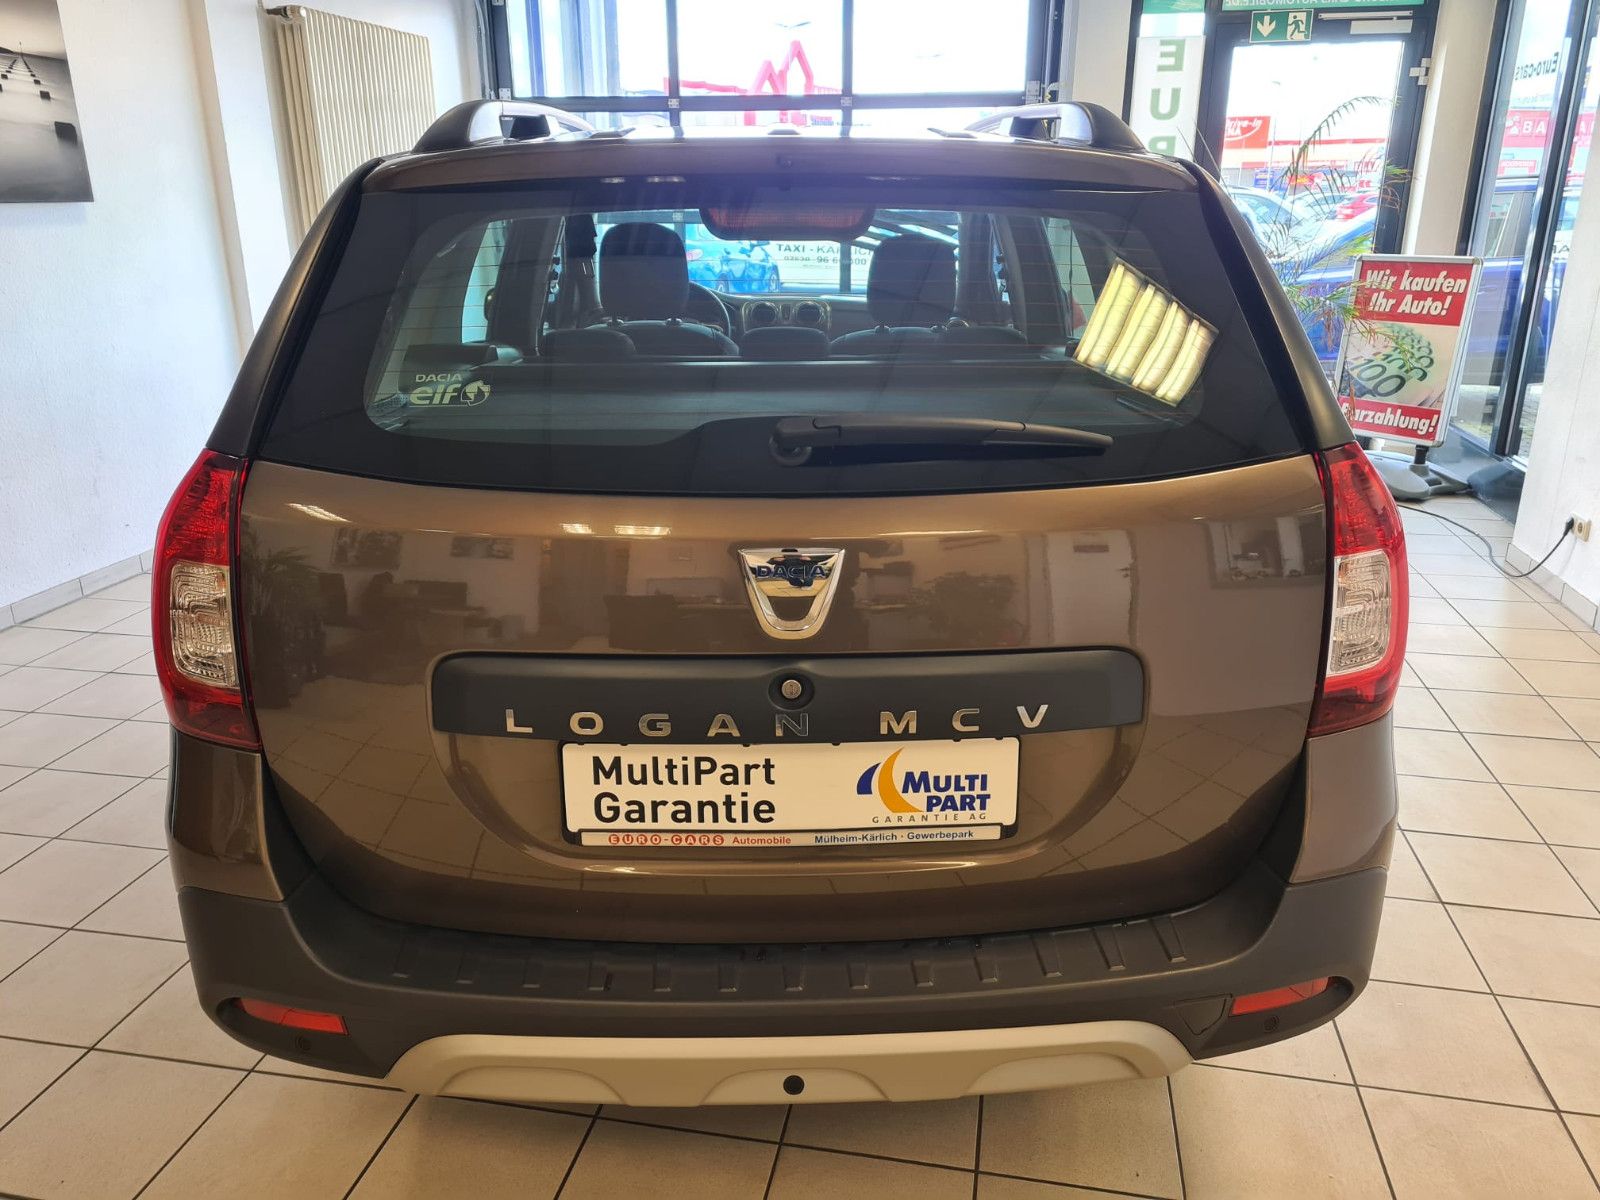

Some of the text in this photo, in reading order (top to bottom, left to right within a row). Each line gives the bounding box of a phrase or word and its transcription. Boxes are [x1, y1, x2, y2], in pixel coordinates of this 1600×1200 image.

[776, 243, 806, 253] TAXI
[1365, 269, 1468, 293] Wir kaufen
[1367, 292, 1453, 316] Ihr Auto!
[415, 373, 462, 382] DACIA
[409, 383, 461, 405] elf
[756, 564, 827, 579] DACIA
[505, 704, 1049, 738] LOGAN MCV
[592, 755, 775, 785] MultiPart
[593, 791, 776, 823] Garantie
[926, 793, 991, 812] PART
[872, 812, 986, 824] GARANTIE AG
[608, 830, 974, 847] EURO-CARS Automobile Mülheim-Kärlich Gewerbepark
